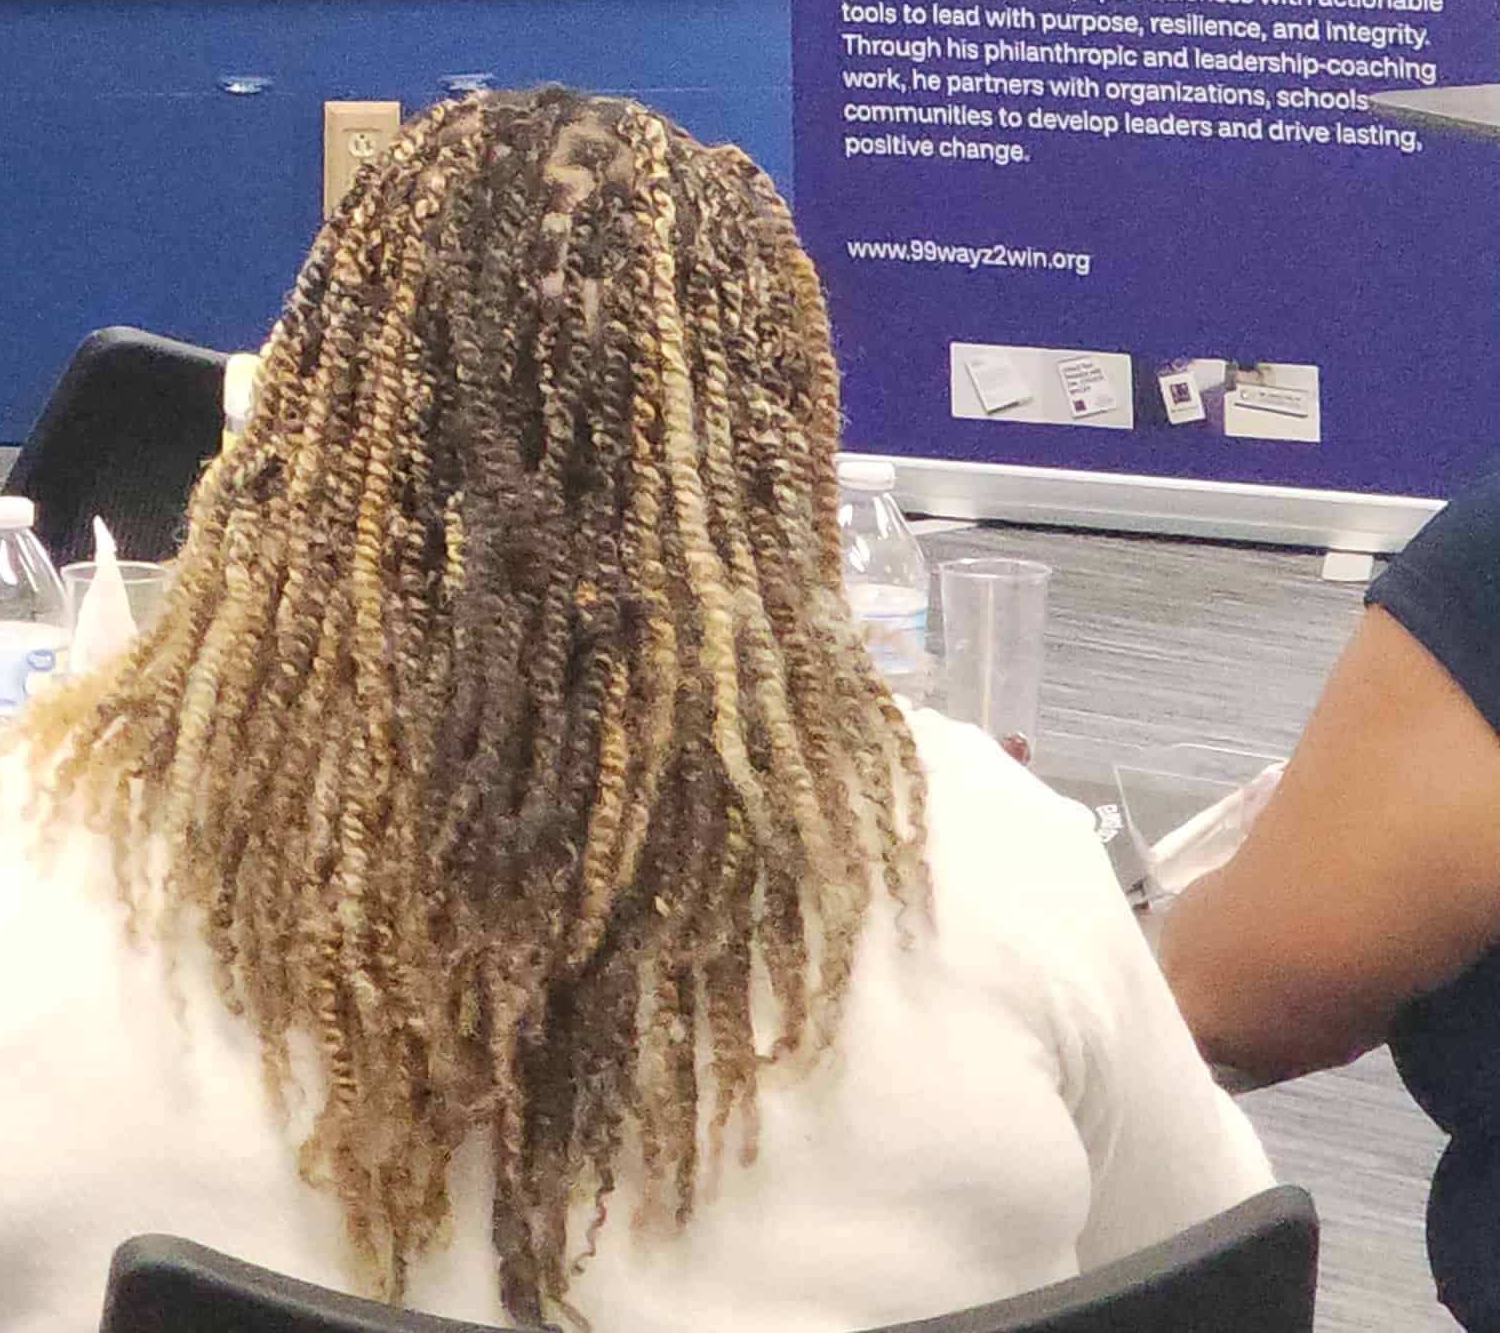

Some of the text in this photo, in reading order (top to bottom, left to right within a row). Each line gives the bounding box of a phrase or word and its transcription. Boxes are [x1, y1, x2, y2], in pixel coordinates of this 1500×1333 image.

[841, 1, 1431, 51] tools to lead with purpose, resilience, and integrity.
[841, 33, 1437, 84] Through his philanthropic and leadership-coaching
[842, 67, 907, 94] work,
[912, 68, 942, 91] he
[946, 72, 1045, 97] partners
[1047, 76, 1100, 98] with
[1105, 80, 1271, 111] organizations,
[843, 103, 1423, 153] communities to develop leaders and drive lasting,
[844, 134, 1030, 166] positive change.
[847, 239, 1092, 276] www.99wayz2win.org
